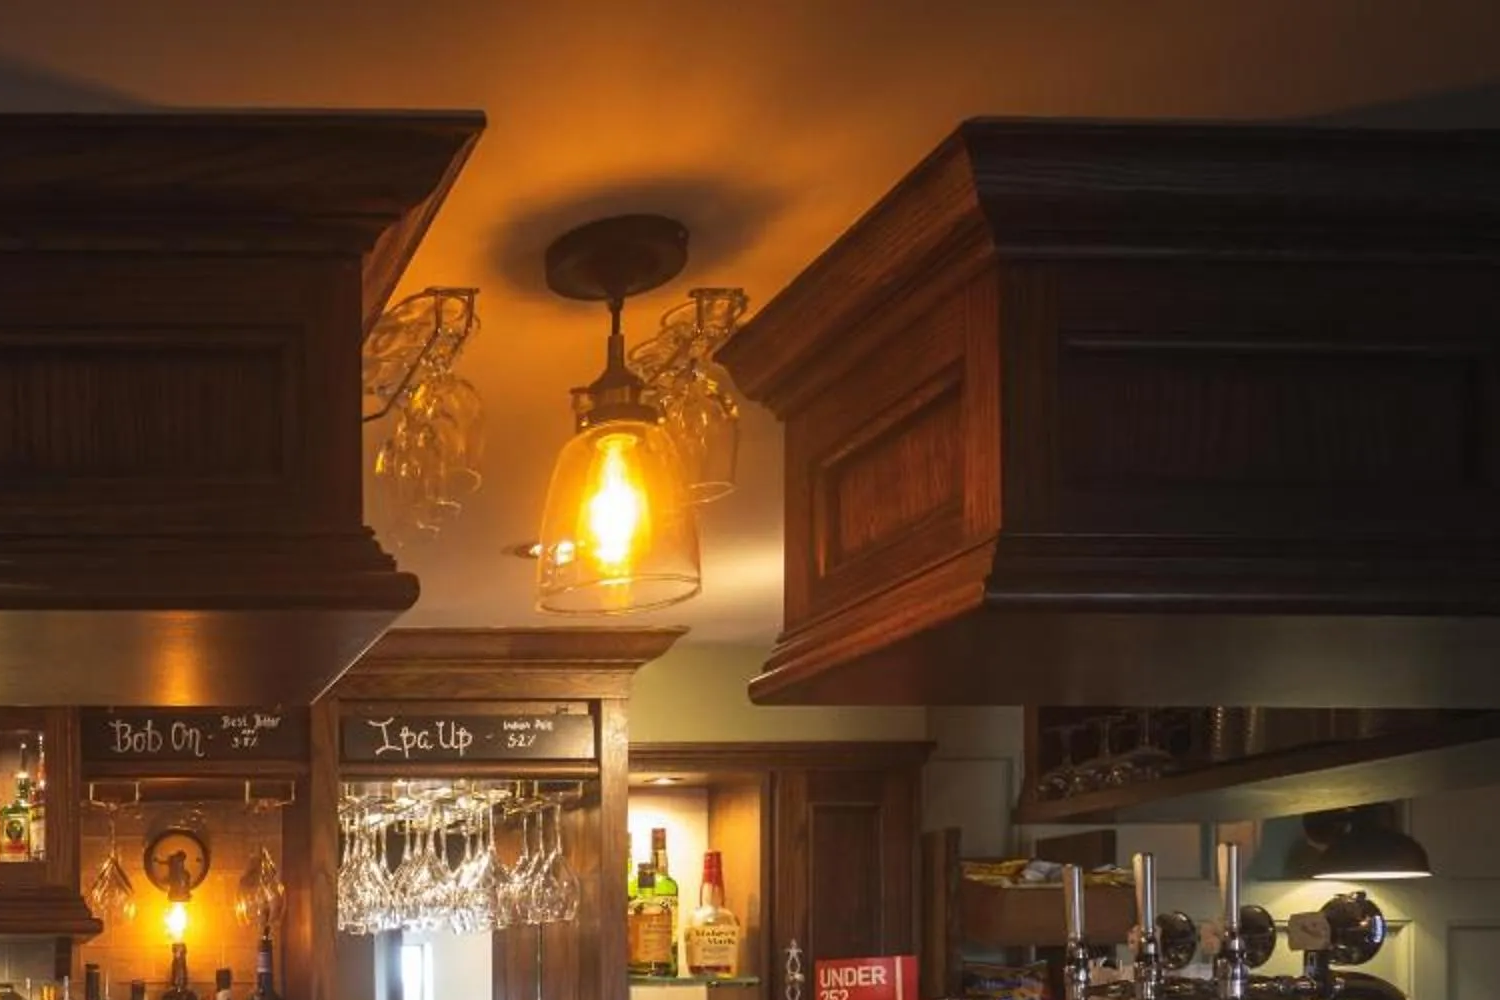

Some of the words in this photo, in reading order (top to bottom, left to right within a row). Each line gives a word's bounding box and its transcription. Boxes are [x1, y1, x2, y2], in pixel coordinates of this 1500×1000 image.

[109, 719, 164, 753] Bob
[171, 721, 205, 757] On
[368, 717, 434, 759] Ipa
[436, 721, 473, 758] Up
[819, 965, 888, 988] UNDER
